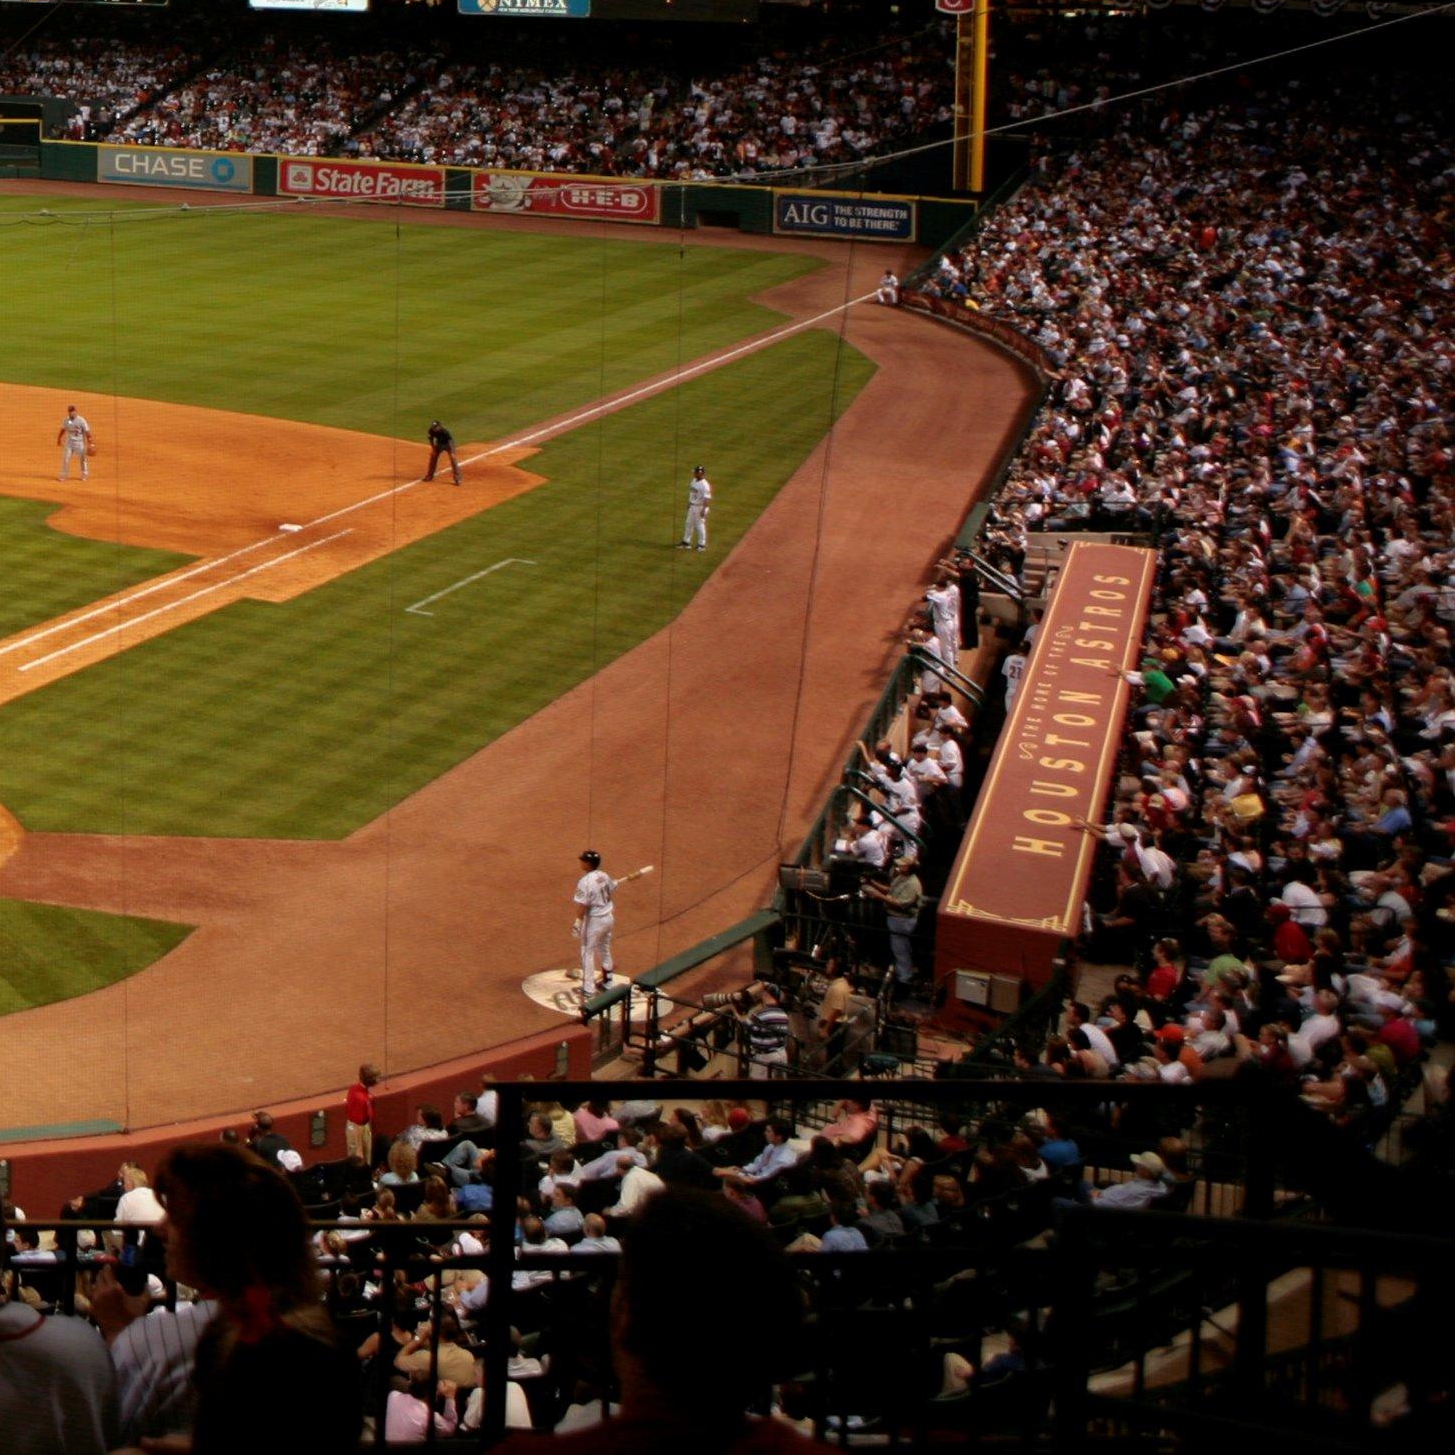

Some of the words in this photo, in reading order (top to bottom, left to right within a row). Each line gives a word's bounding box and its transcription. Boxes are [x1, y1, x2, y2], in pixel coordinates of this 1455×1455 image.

[114, 152, 205, 179] CHASE
[315, 167, 374, 195] State
[375, 172, 436, 199] Farm
[571, 190, 640, 210] H-E-B
[783, 203, 830, 226] AIG
[834, 205, 852, 216] THE
[854, 206, 908, 220] STRENGTH
[834, 217, 846, 227] TO
[847, 217, 863, 228] BE
[1012, 690, 1102, 857] HOUSTON
[1070, 574, 1131, 670] ASTROS
